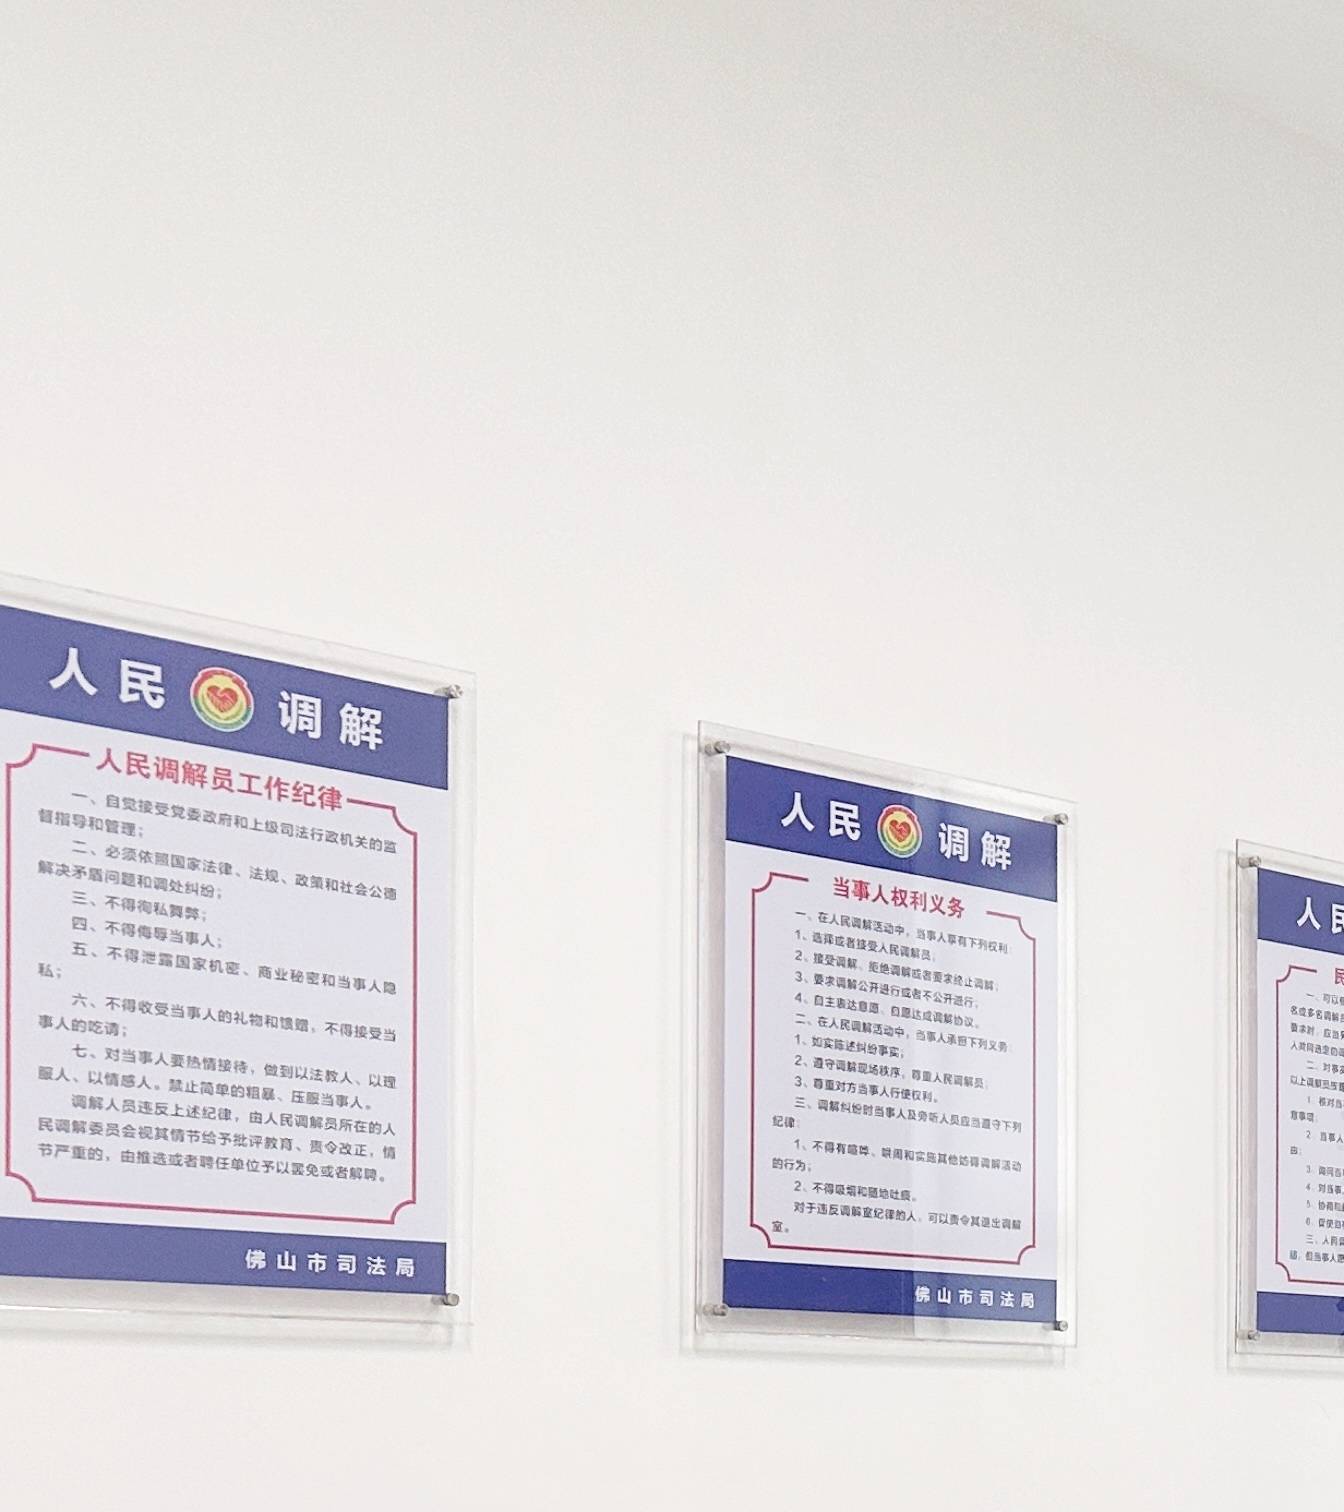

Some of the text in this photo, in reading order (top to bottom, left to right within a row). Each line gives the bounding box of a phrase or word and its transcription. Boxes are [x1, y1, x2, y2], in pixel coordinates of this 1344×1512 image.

[49, 647, 384, 750] 人民 调解
[96, 747, 343, 812] 人民调解员工作纪律
[781, 791, 1012, 871] 人民 调解
[832, 876, 965, 918] 当事人权利义务
[245, 1249, 416, 1277] 佛山市司法局
[915, 1286, 1035, 1308] 佛山市司法局
